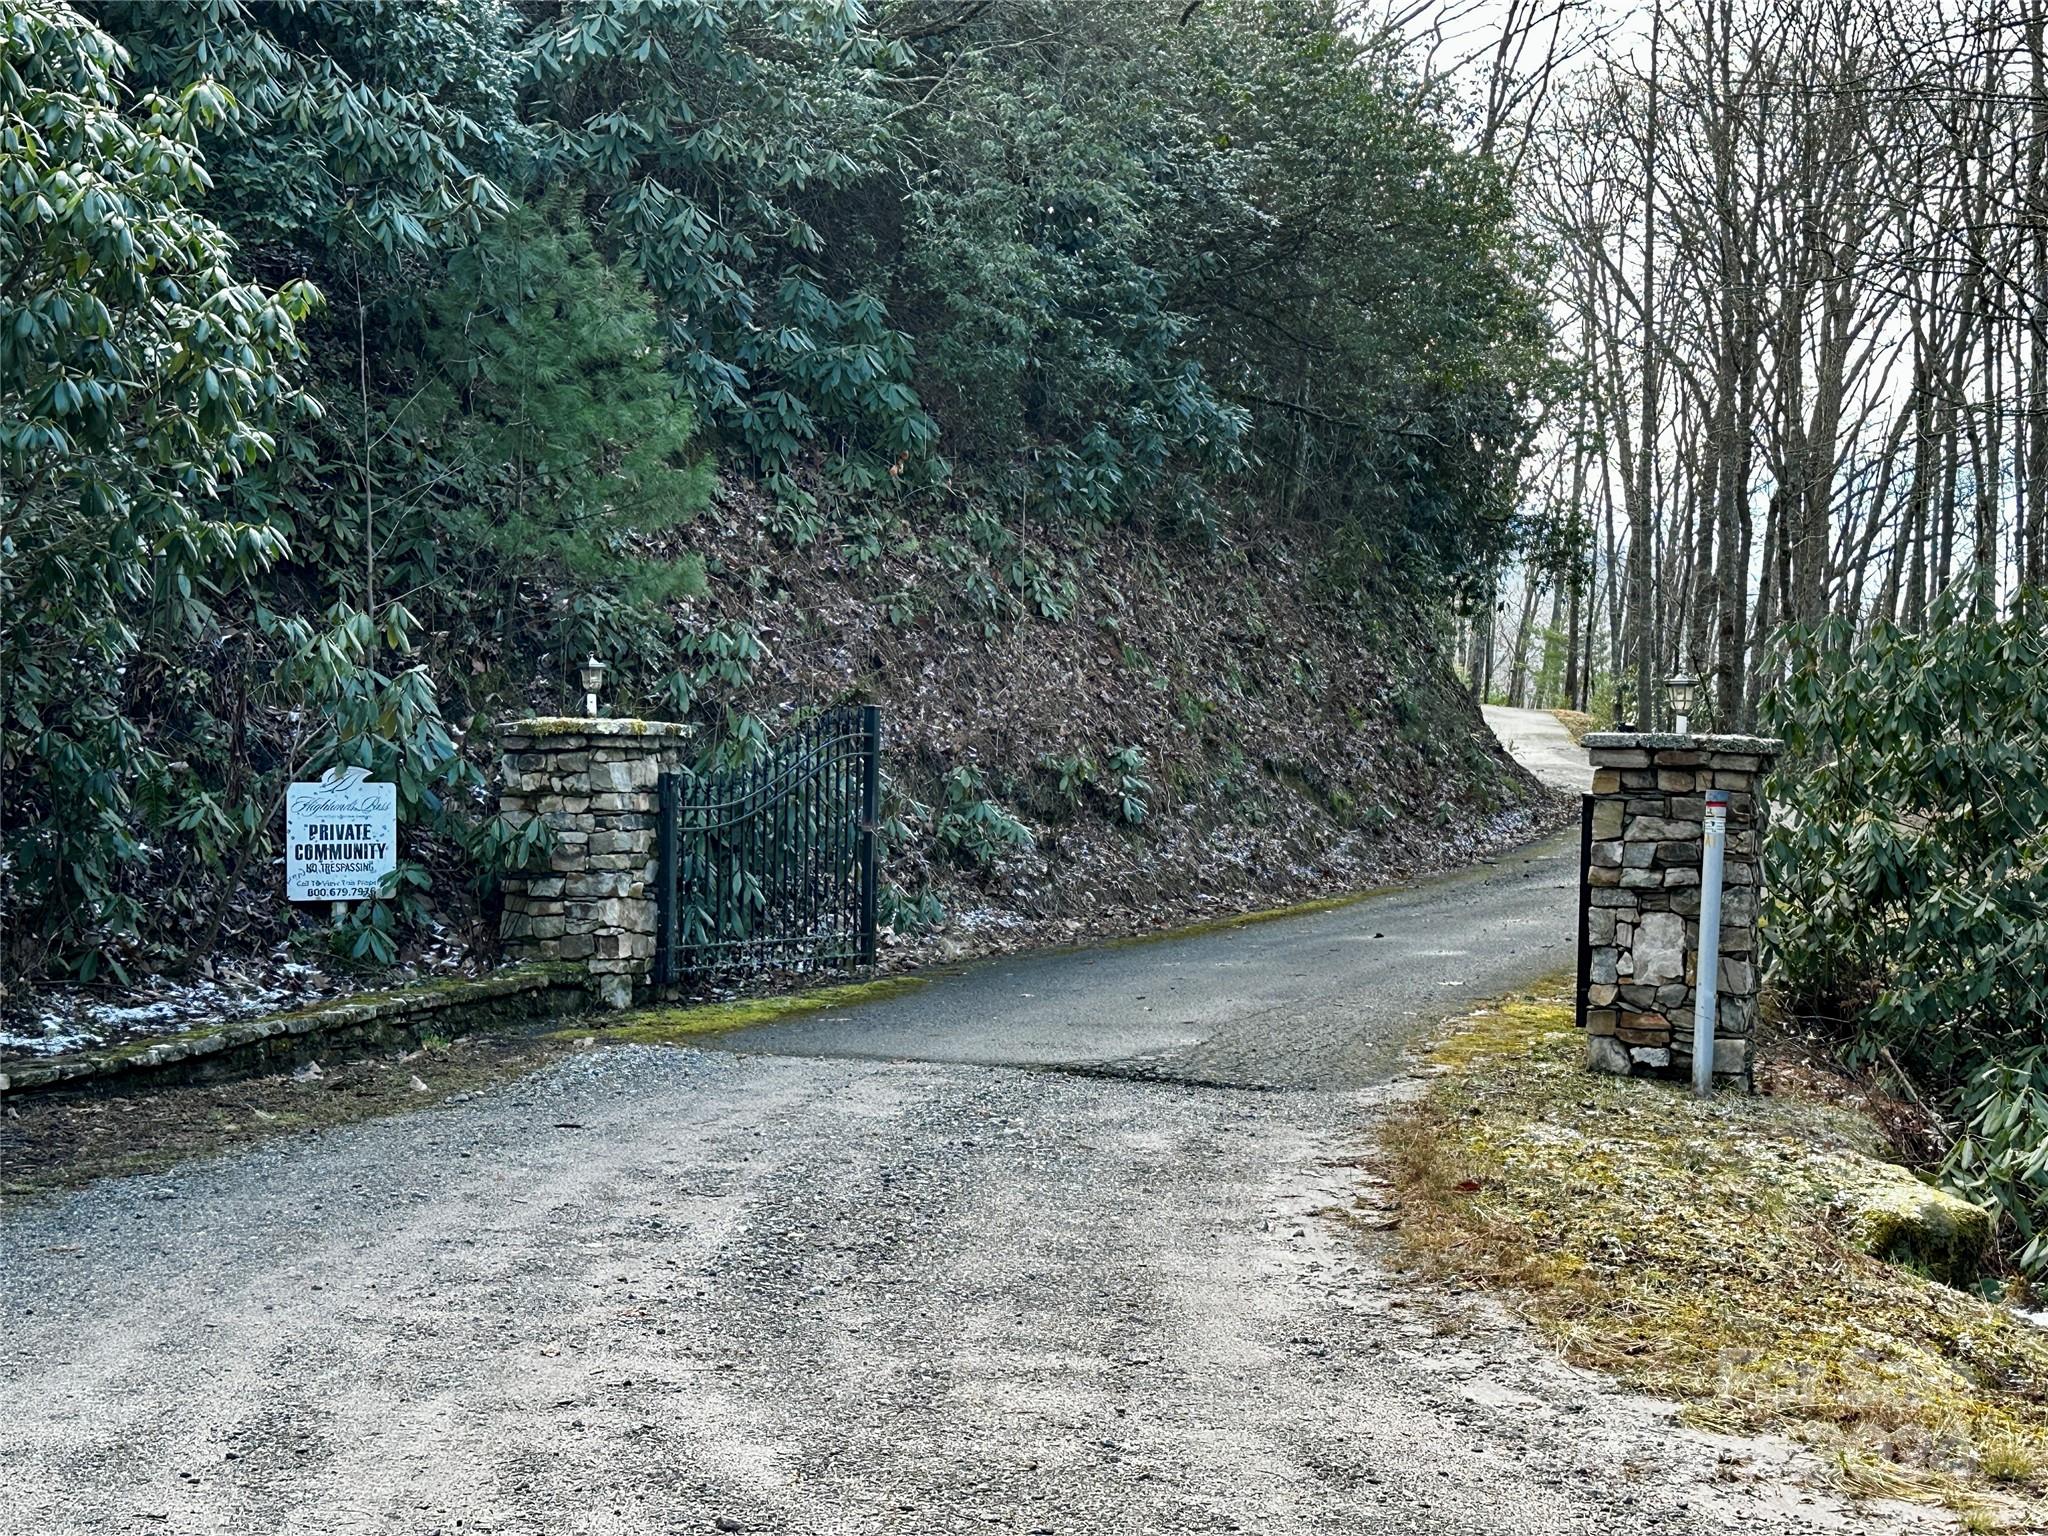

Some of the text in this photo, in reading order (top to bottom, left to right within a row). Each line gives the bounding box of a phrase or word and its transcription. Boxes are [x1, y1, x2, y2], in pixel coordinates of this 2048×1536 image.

[308, 823, 372, 841] PRIVATE
[294, 843, 387, 860] COMMUNITY
[306, 863, 374, 874] NO TRESPASSING
